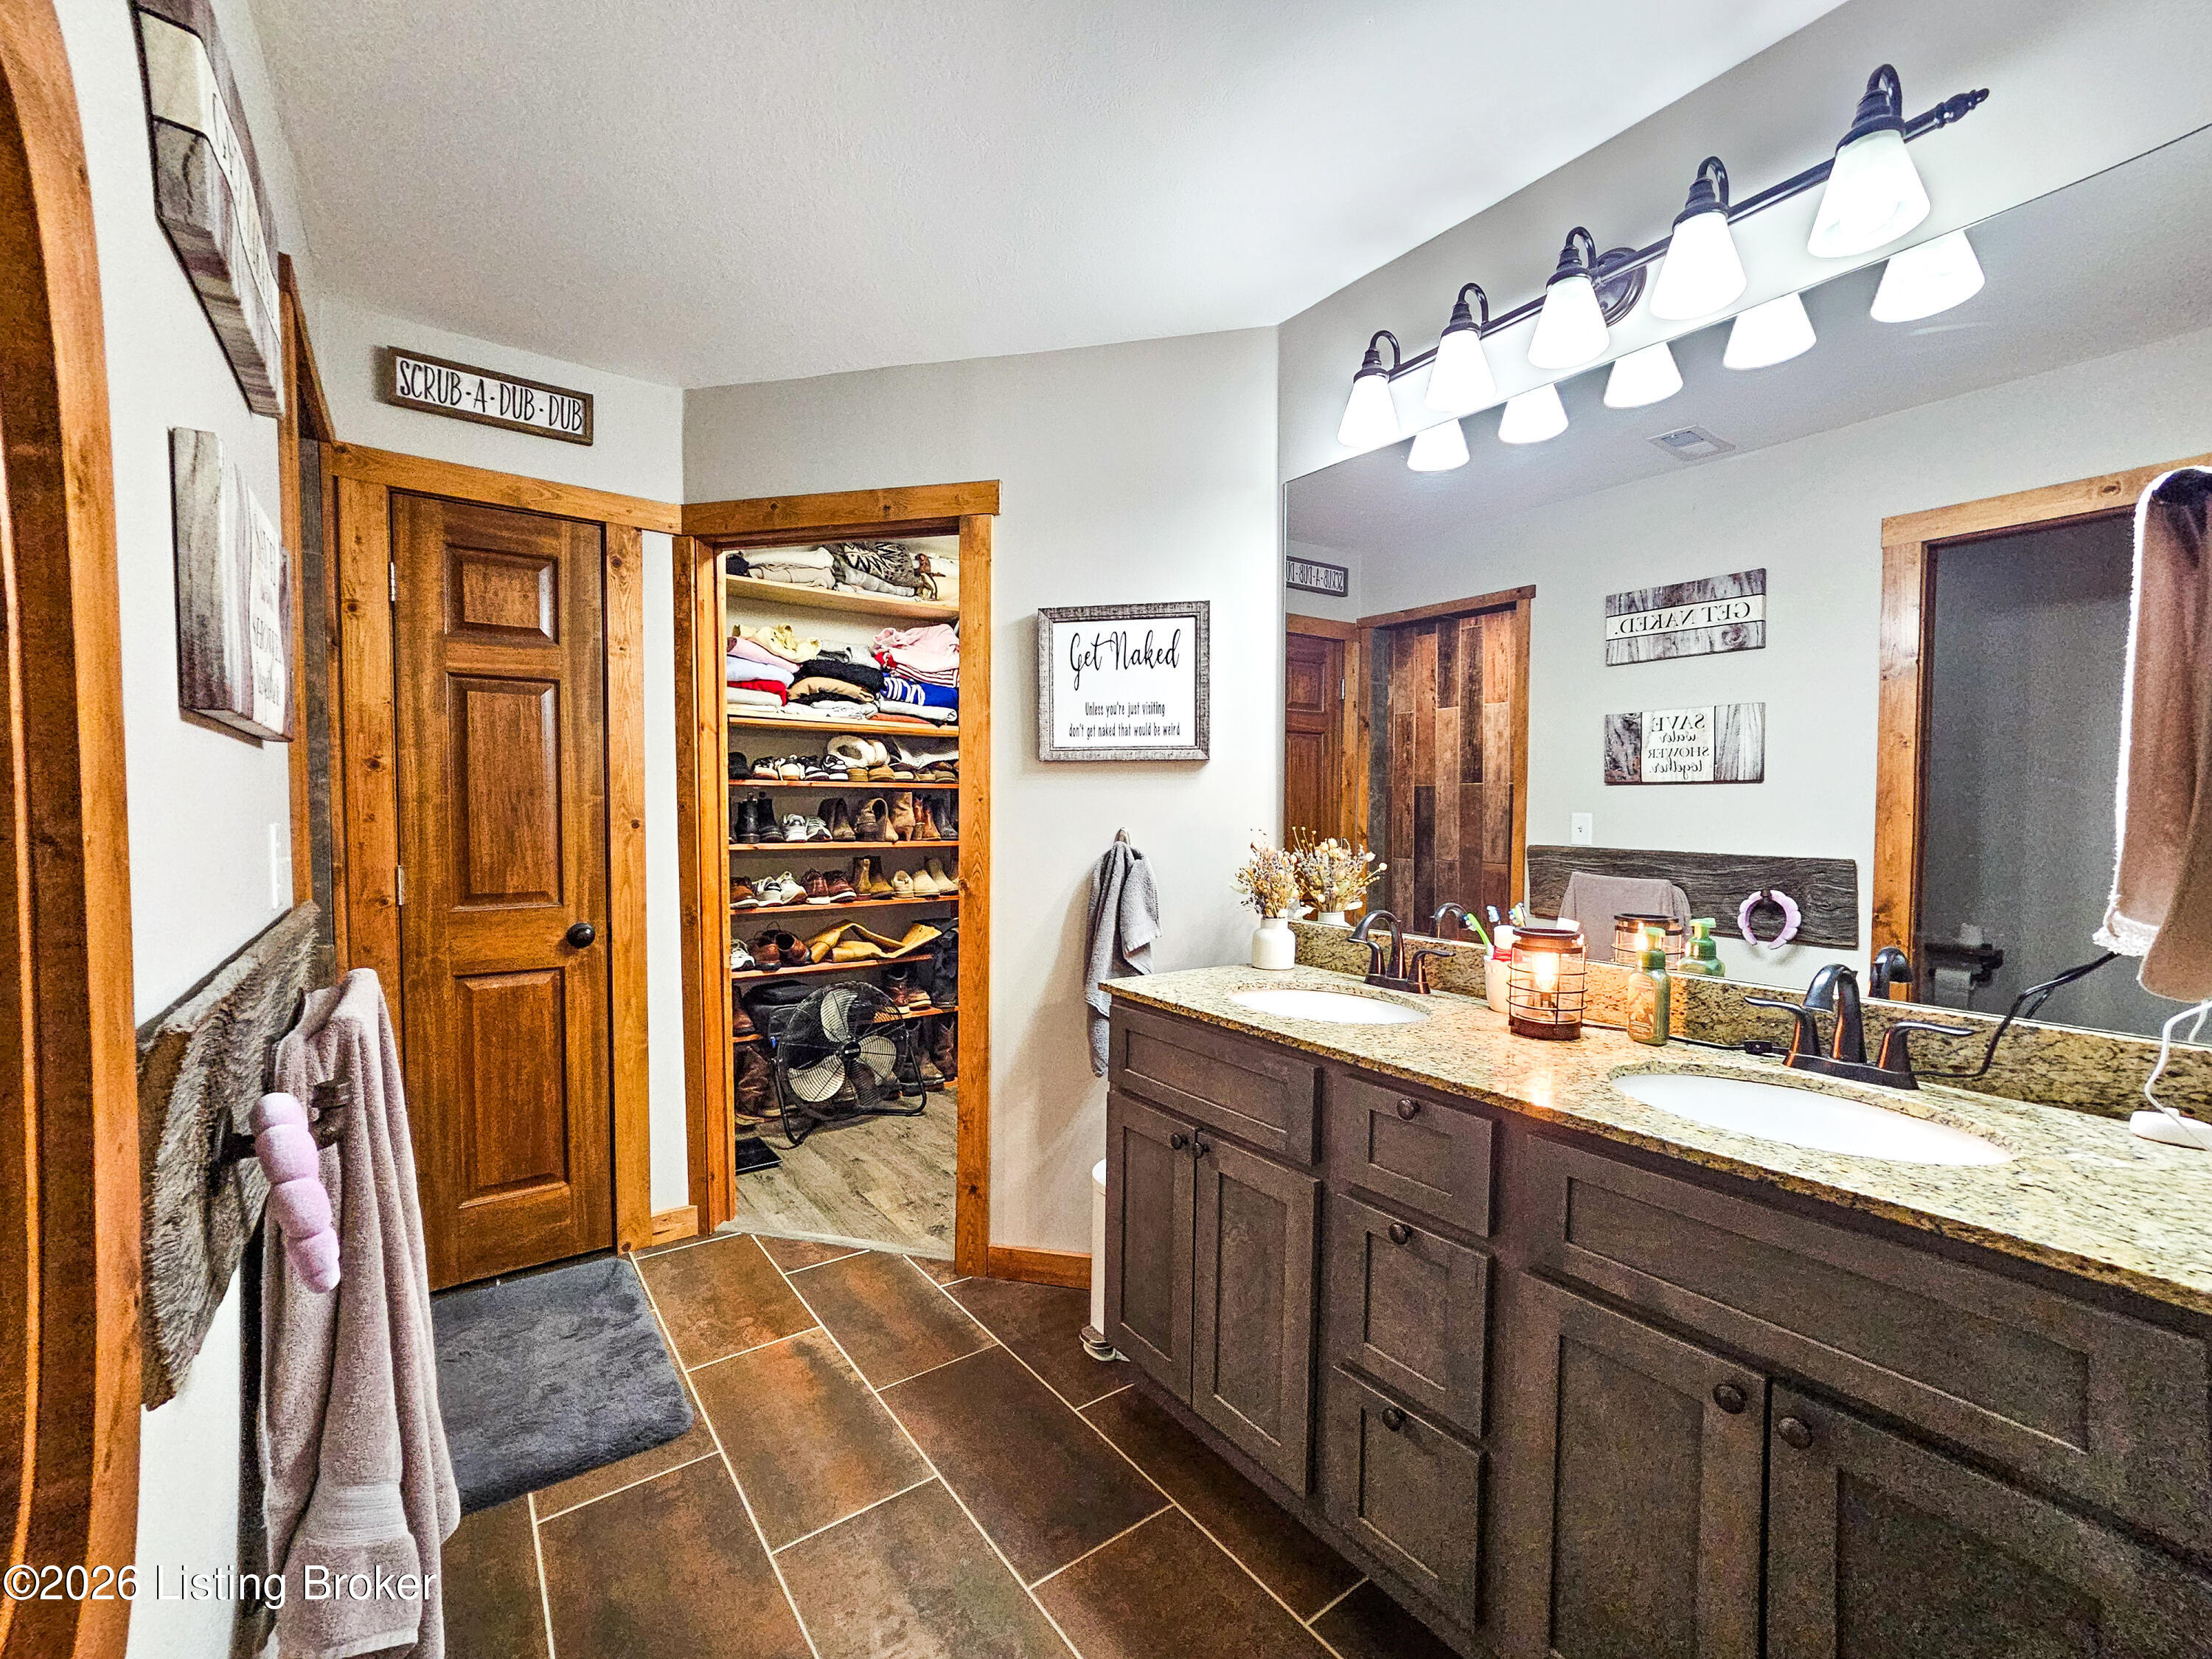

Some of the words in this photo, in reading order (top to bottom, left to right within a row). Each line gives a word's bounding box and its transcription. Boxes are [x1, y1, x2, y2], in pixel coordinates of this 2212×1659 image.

[1070, 632, 1115, 691] Get
[1110, 628, 1180, 670] Naked
[1085, 701, 1104, 715] Unless
[1106, 700, 1124, 718] you're
[1127, 702, 1139, 717] just
[1142, 701, 1165, 717] visiting
[1069, 723, 1084, 737] don't
[1087, 724, 1096, 740] get
[1098, 723, 1116, 737] naked
[1119, 722, 1130, 737] that
[1134, 722, 1151, 737] would
[1154, 721, 1161, 736] be
[1163, 721, 1180, 736] weird
